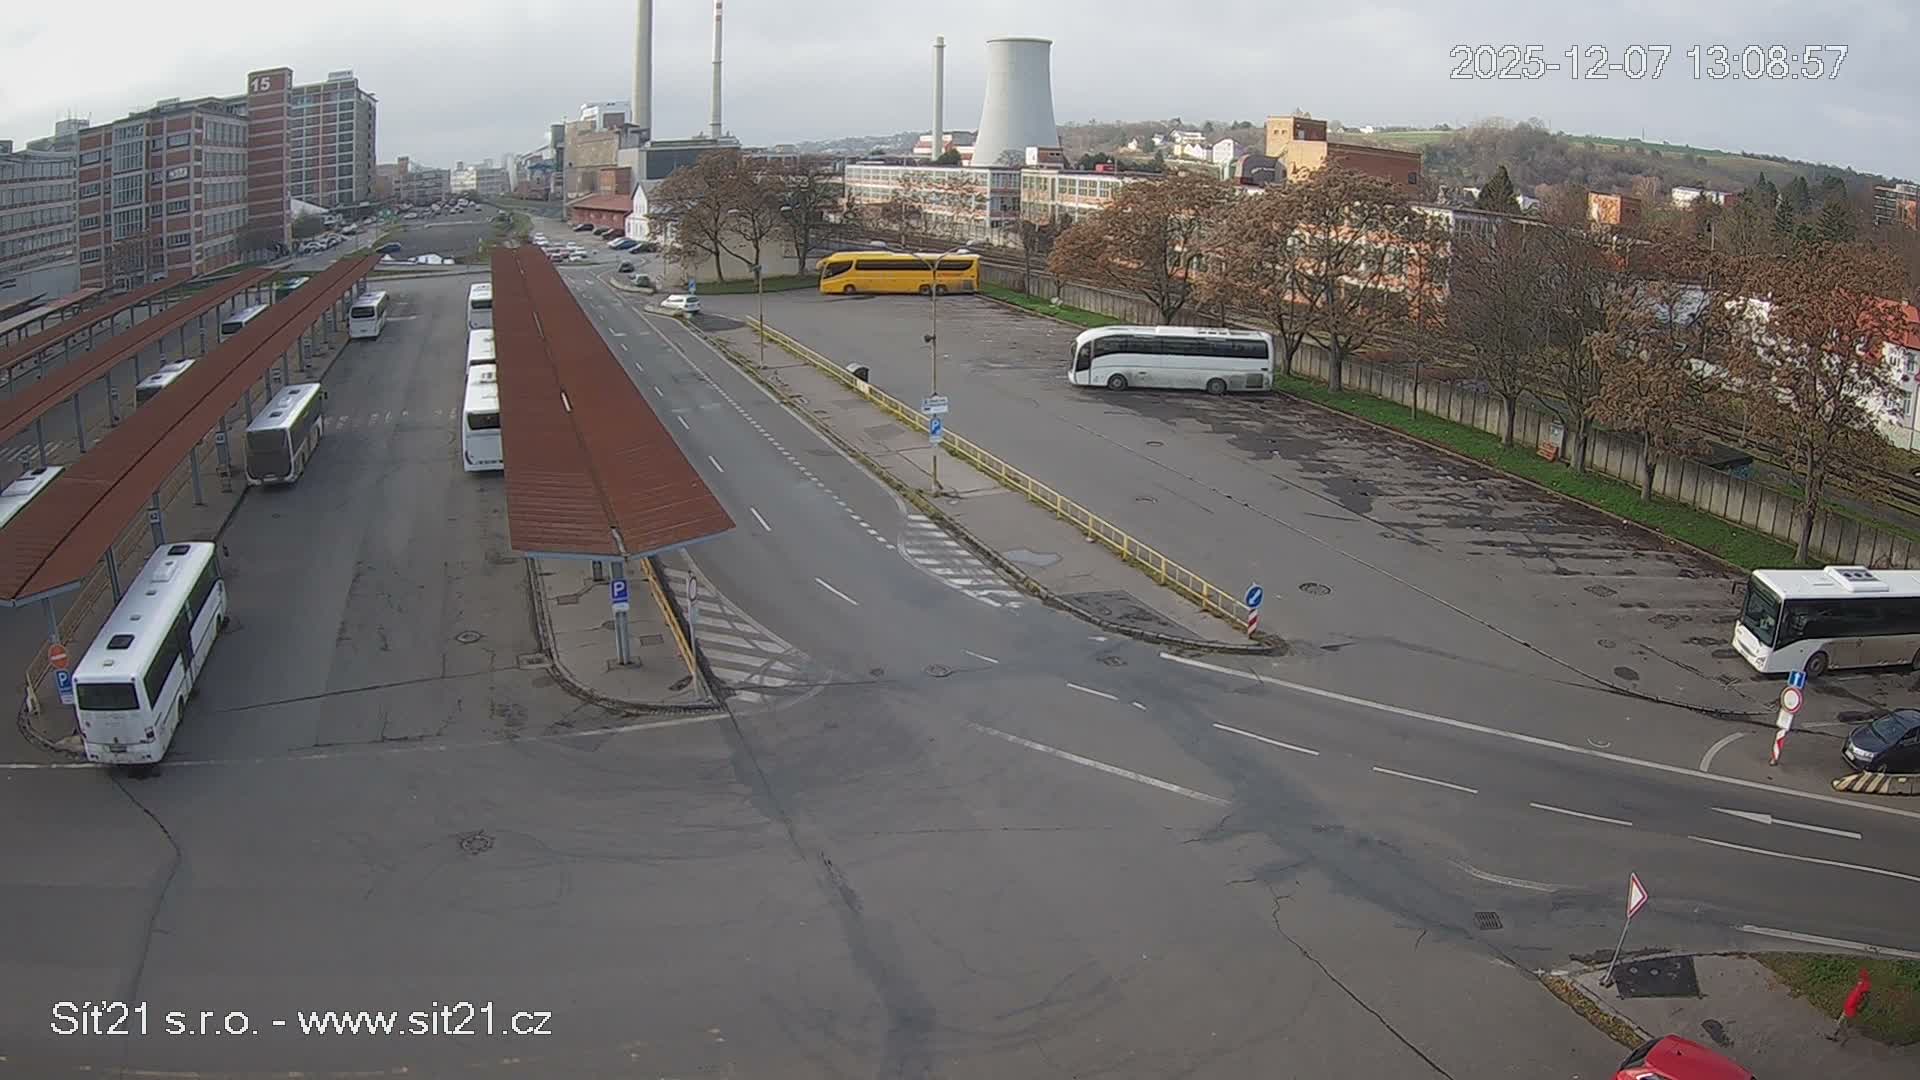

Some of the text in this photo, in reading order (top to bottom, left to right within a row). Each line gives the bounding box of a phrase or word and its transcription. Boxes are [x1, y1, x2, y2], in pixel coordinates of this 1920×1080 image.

[250, 76, 271, 92] 15
[613, 581, 625, 597] P
[58, 672, 68, 687] P
